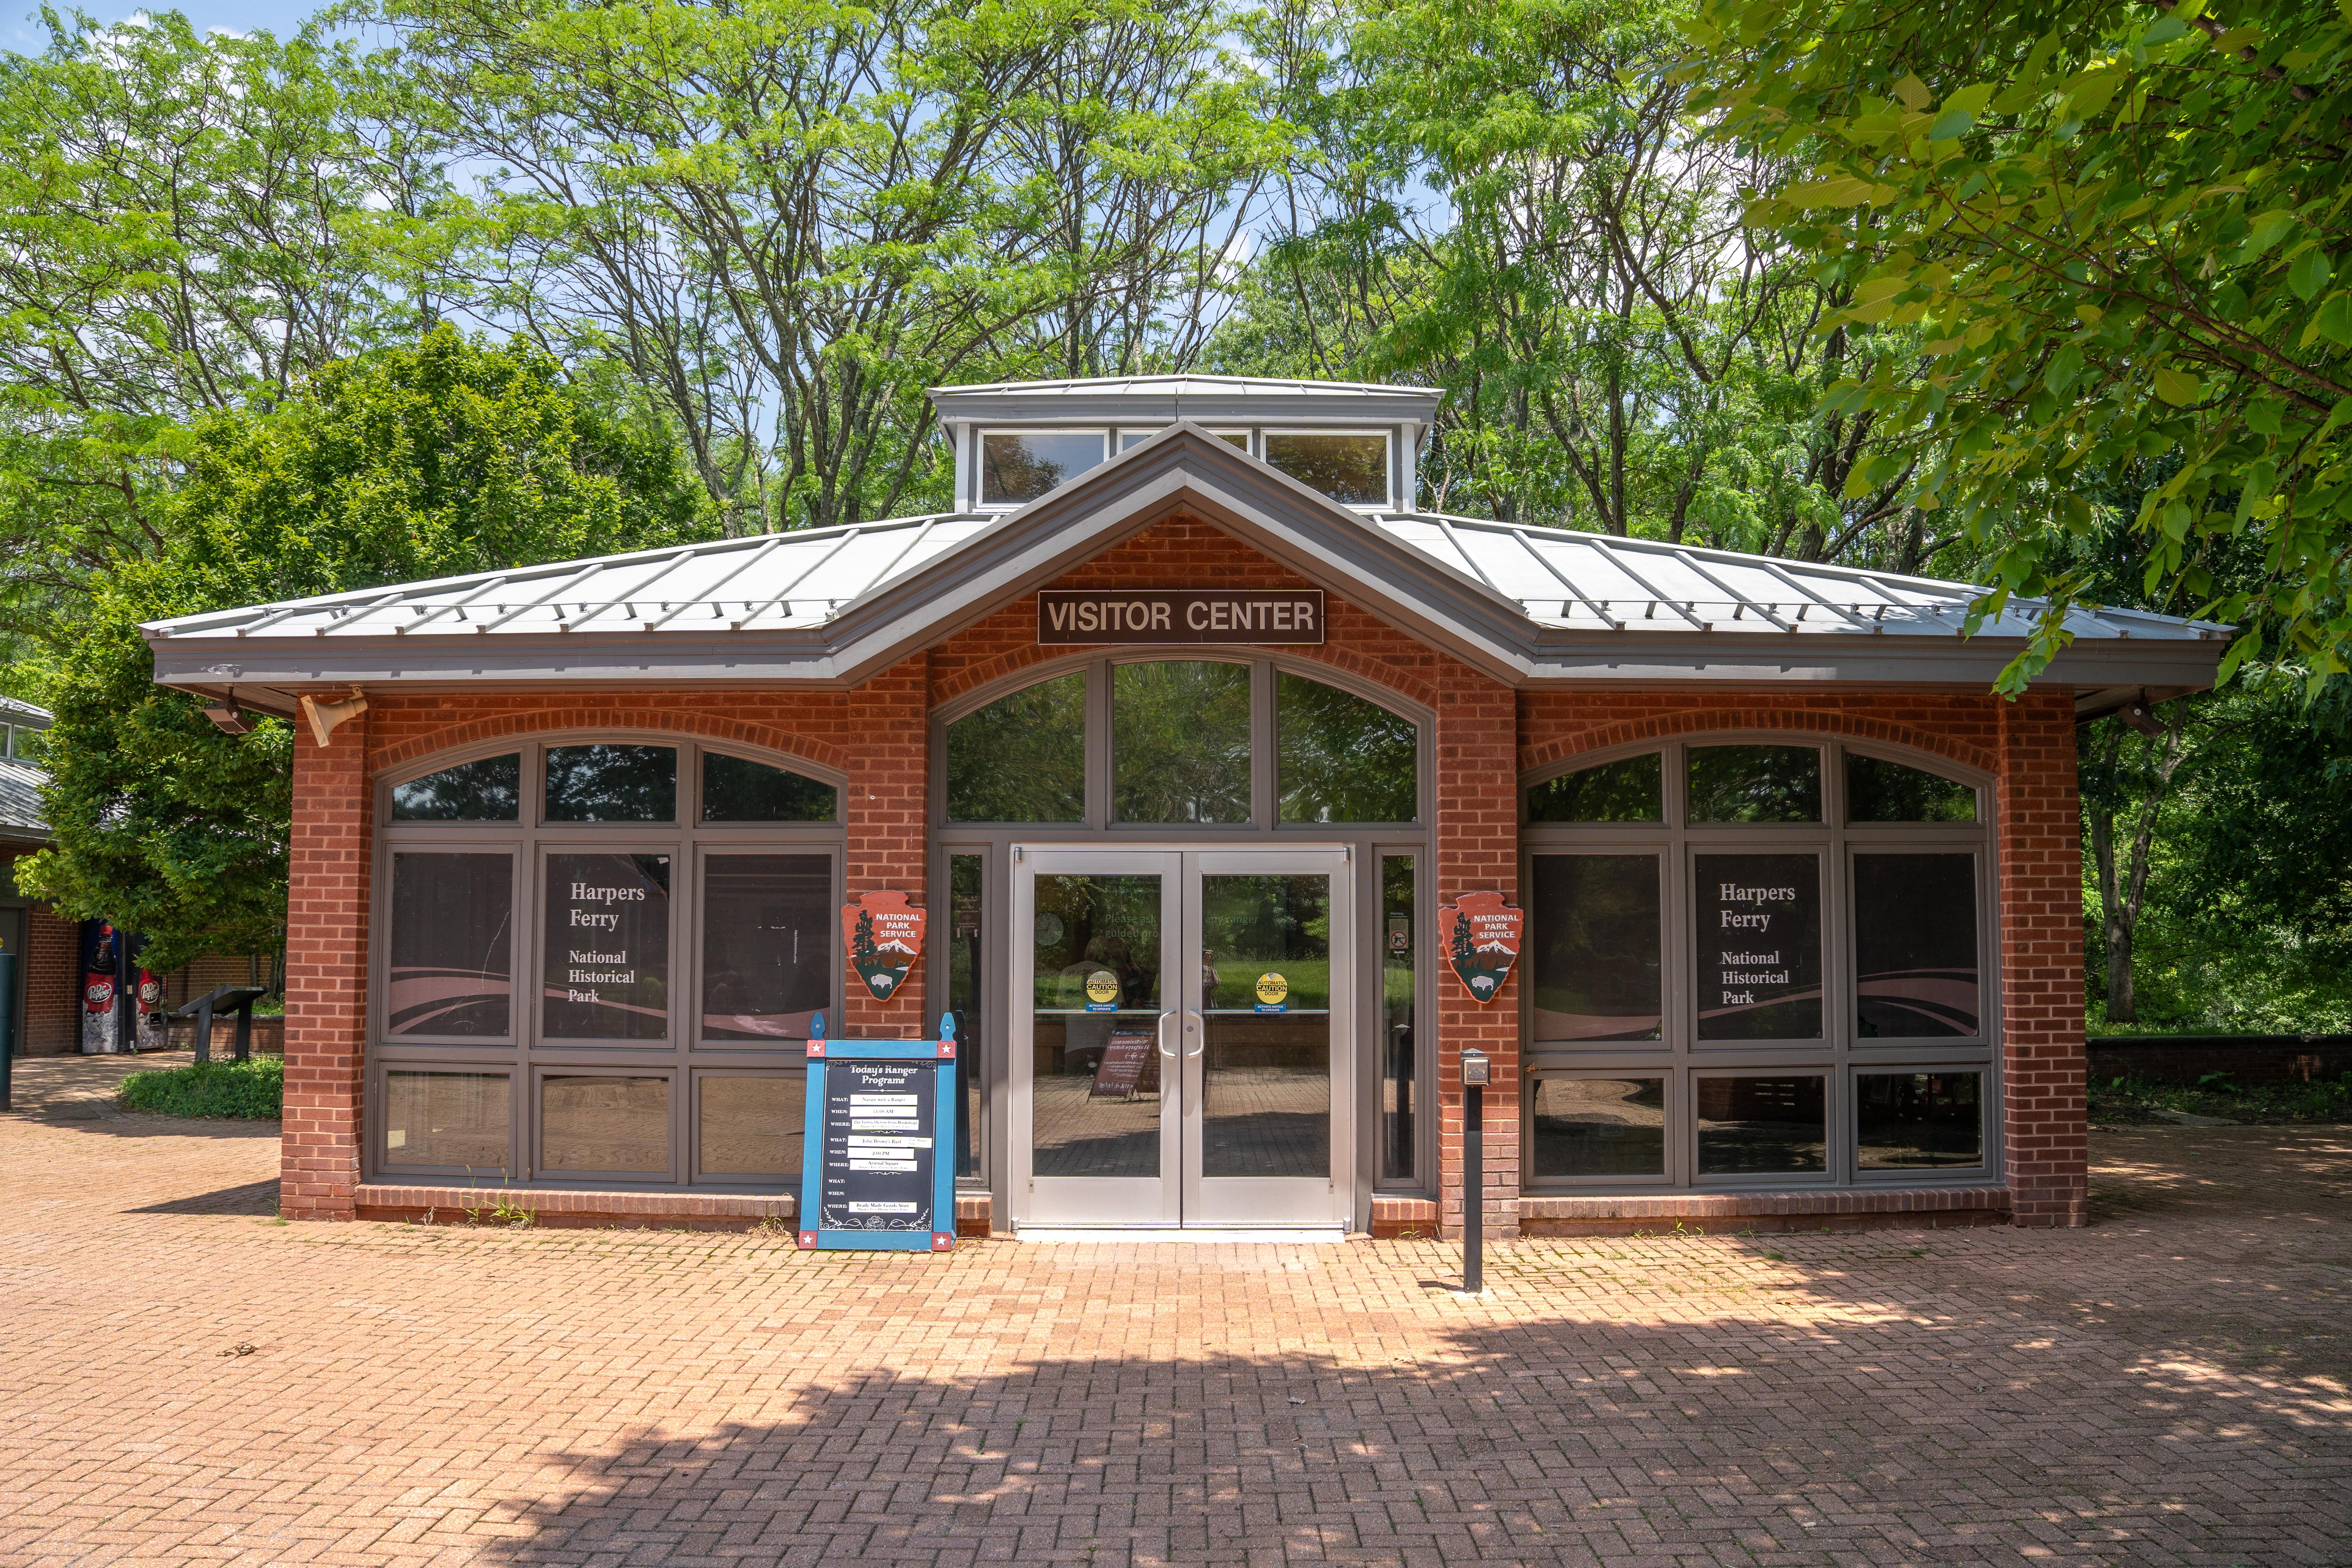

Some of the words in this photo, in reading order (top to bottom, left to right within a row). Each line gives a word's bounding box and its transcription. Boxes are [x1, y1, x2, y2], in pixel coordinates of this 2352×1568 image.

[1048, 602, 1171, 630] VISITOR
[1187, 602, 1314, 630] CENTER
[570, 883, 645, 905] Harpers
[1720, 884, 1796, 905] Harpers
[570, 909, 619, 931] Ferry
[1105, 915, 1138, 923] Please
[1140, 914, 1157, 923] ask
[1205, 917, 1224, 926] any
[1226, 916, 1259, 926] ranger
[1721, 910, 1771, 932] Ferry
[1105, 929, 1139, 939] guided
[1142, 930, 1160, 939] pro
[569, 950, 626, 963] National
[1722, 951, 1780, 965] National
[568, 970, 635, 983] Historical
[1722, 970, 1789, 984] Historical
[89, 985, 111, 1000] Pepper
[96, 984, 106, 992] Dr
[142, 984, 158, 1000] Pepper
[568, 989, 599, 1002] Park
[1722, 991, 1754, 1004] Park
[850, 1065, 883, 1076] Today's
[885, 1065, 918, 1076] Ranger
[862, 1075, 905, 1086] Programs
